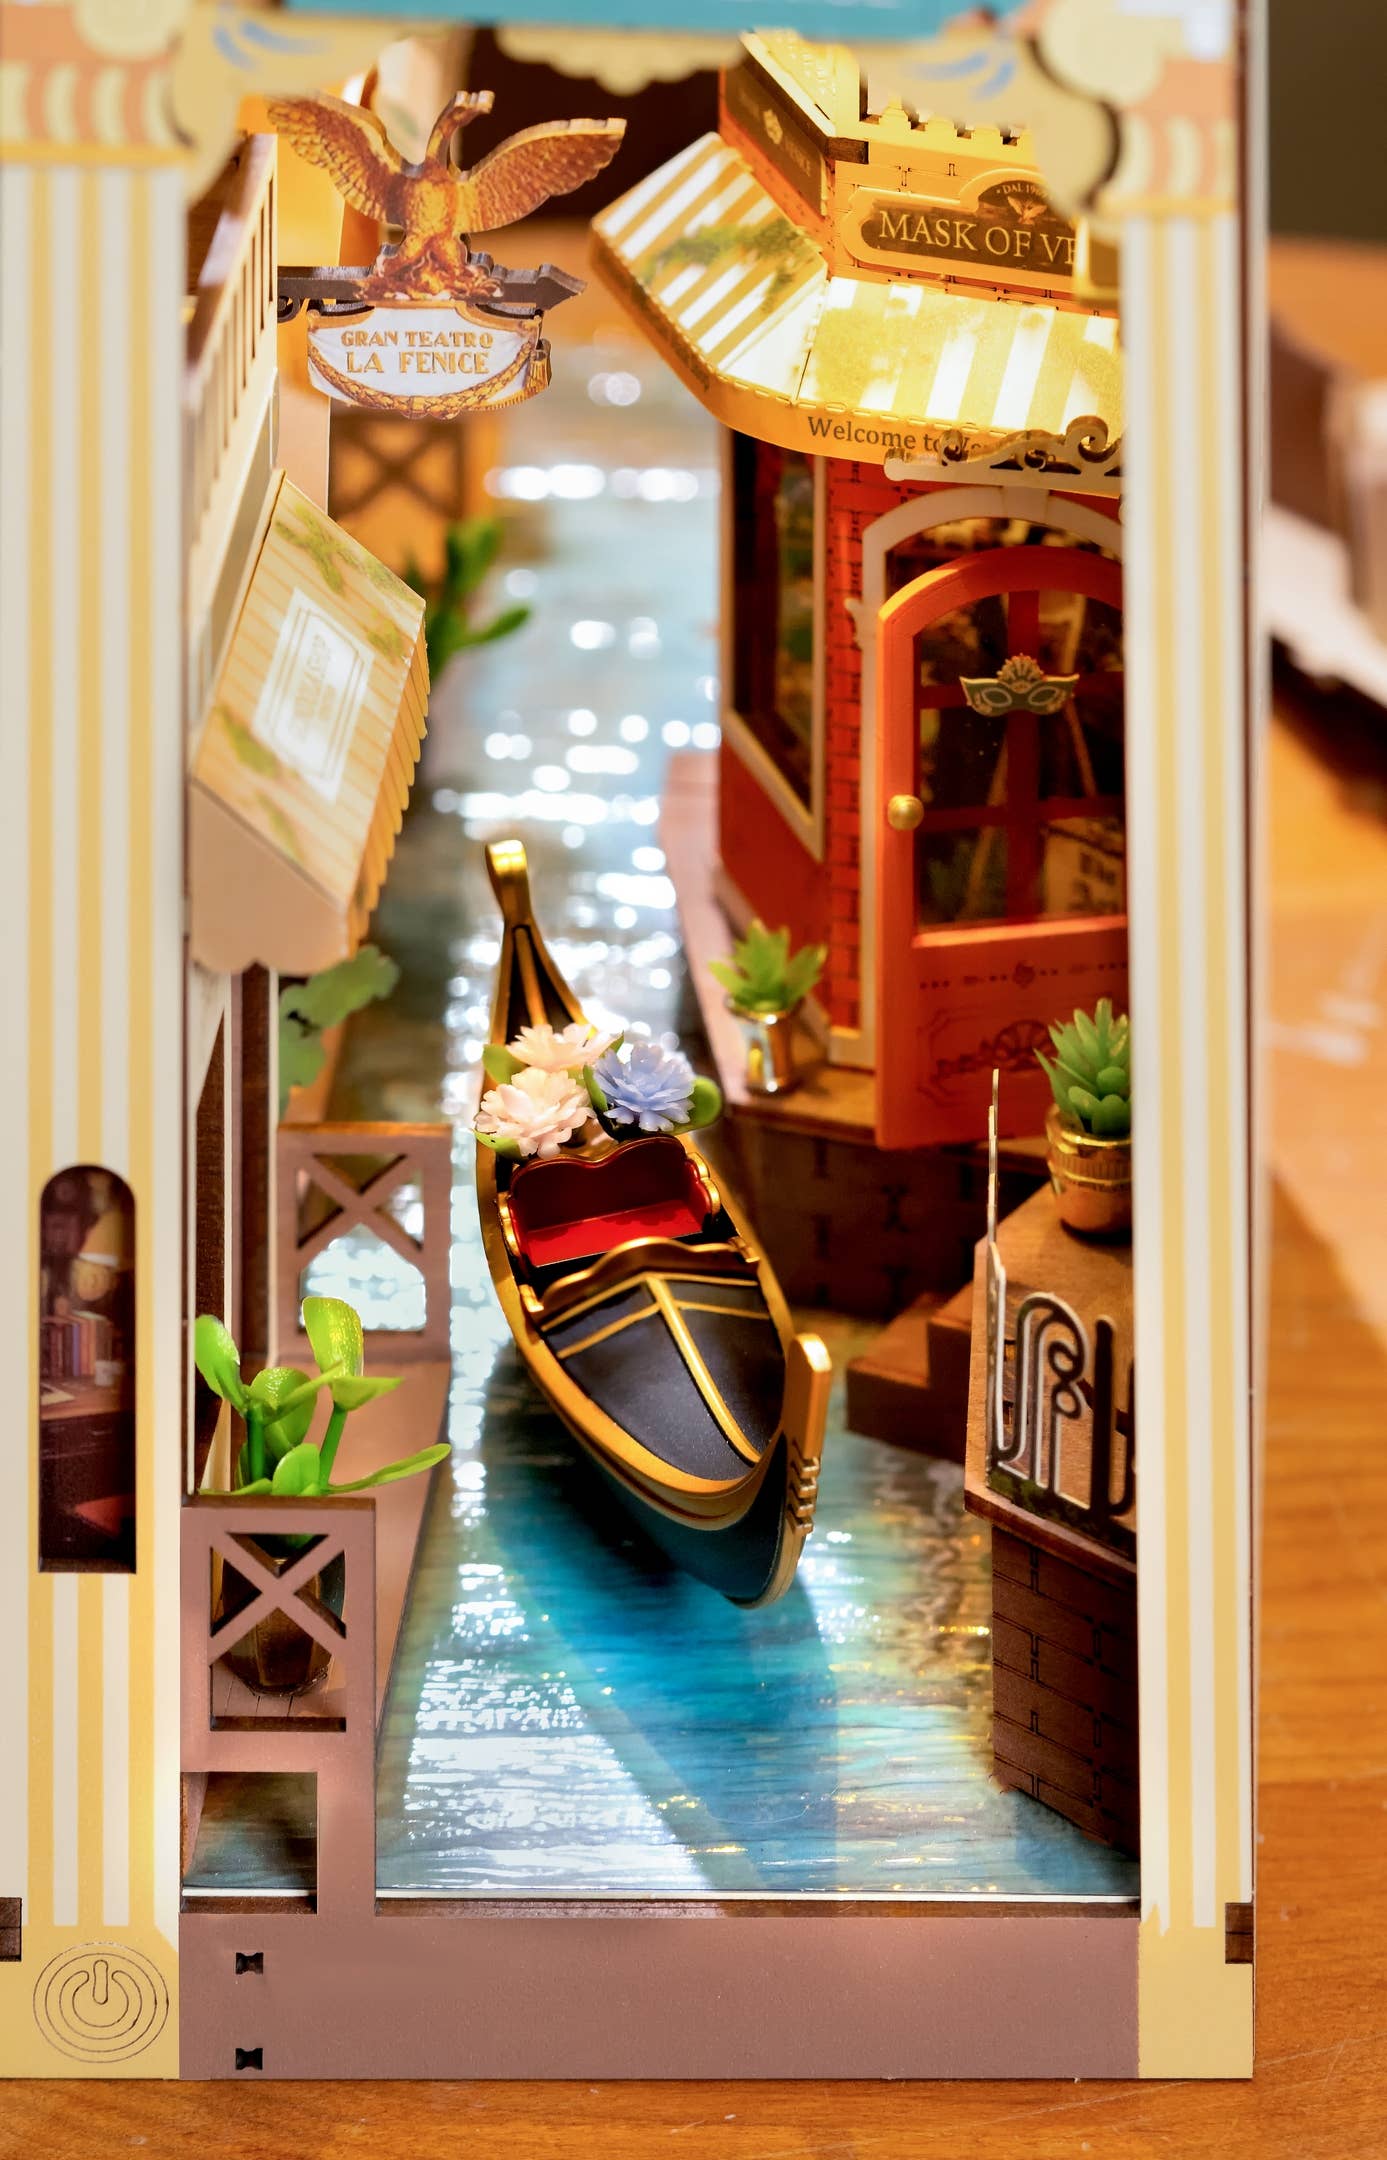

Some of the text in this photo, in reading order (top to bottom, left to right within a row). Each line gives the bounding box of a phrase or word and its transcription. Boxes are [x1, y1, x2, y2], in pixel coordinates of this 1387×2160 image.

[879, 210, 978, 251] MASK
[985, 226, 1032, 258] OF
[341, 330, 494, 349] GRAN TEATRO
[346, 350, 490, 374] LA FENICE
[807, 415, 917, 450] Welcome
